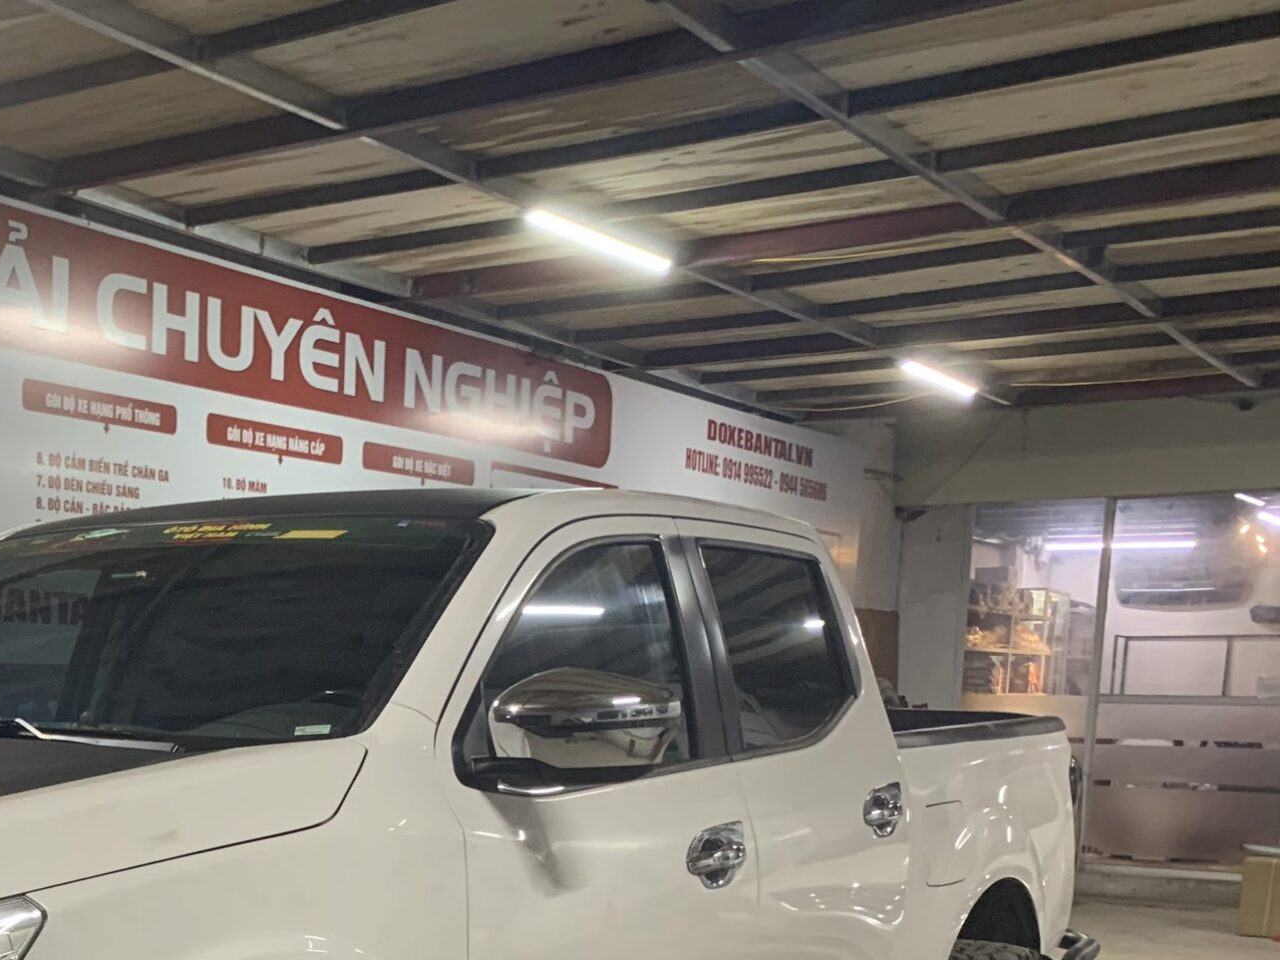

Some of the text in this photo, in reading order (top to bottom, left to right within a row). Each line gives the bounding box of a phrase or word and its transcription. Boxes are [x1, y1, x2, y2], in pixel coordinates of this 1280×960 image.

[96, 272, 386, 402] CHUYÊN
[404, 347, 595, 452] NGHIỆP
[254, 431, 265, 446] XE
[685, 447, 721, 476] HOTLINE:
[722, 457, 741, 482] 0914
